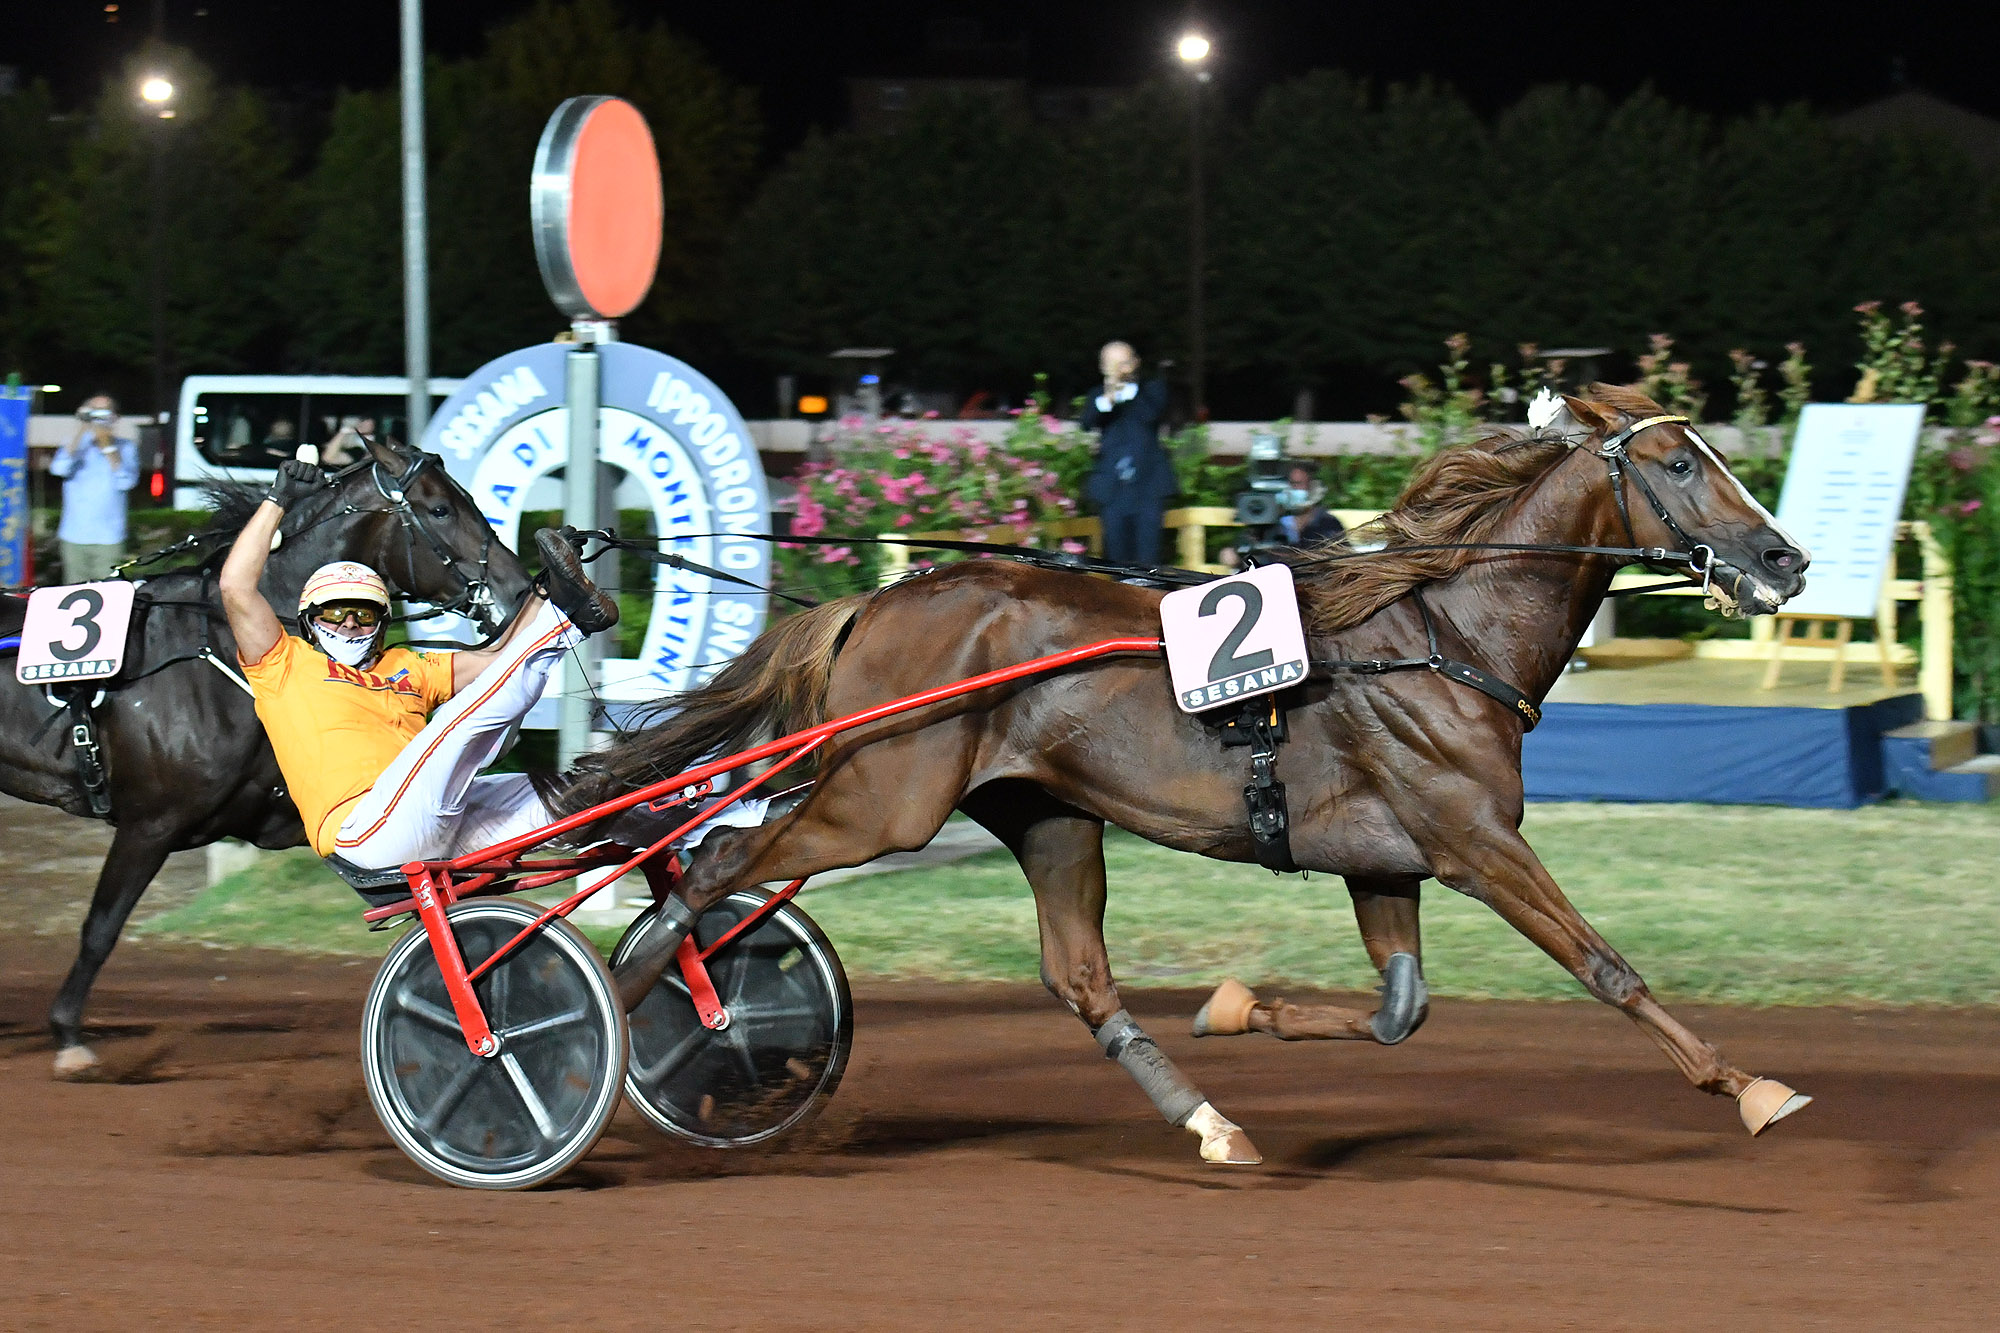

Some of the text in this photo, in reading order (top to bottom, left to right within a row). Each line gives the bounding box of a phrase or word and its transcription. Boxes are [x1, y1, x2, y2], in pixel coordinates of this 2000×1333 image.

[646, 371, 759, 570] IPPODROMO
[49, 588, 104, 662] 3
[1198, 580, 1275, 684] 2
[24, 660, 111, 679] SESANA
[1189, 663, 1298, 707] SESANA
